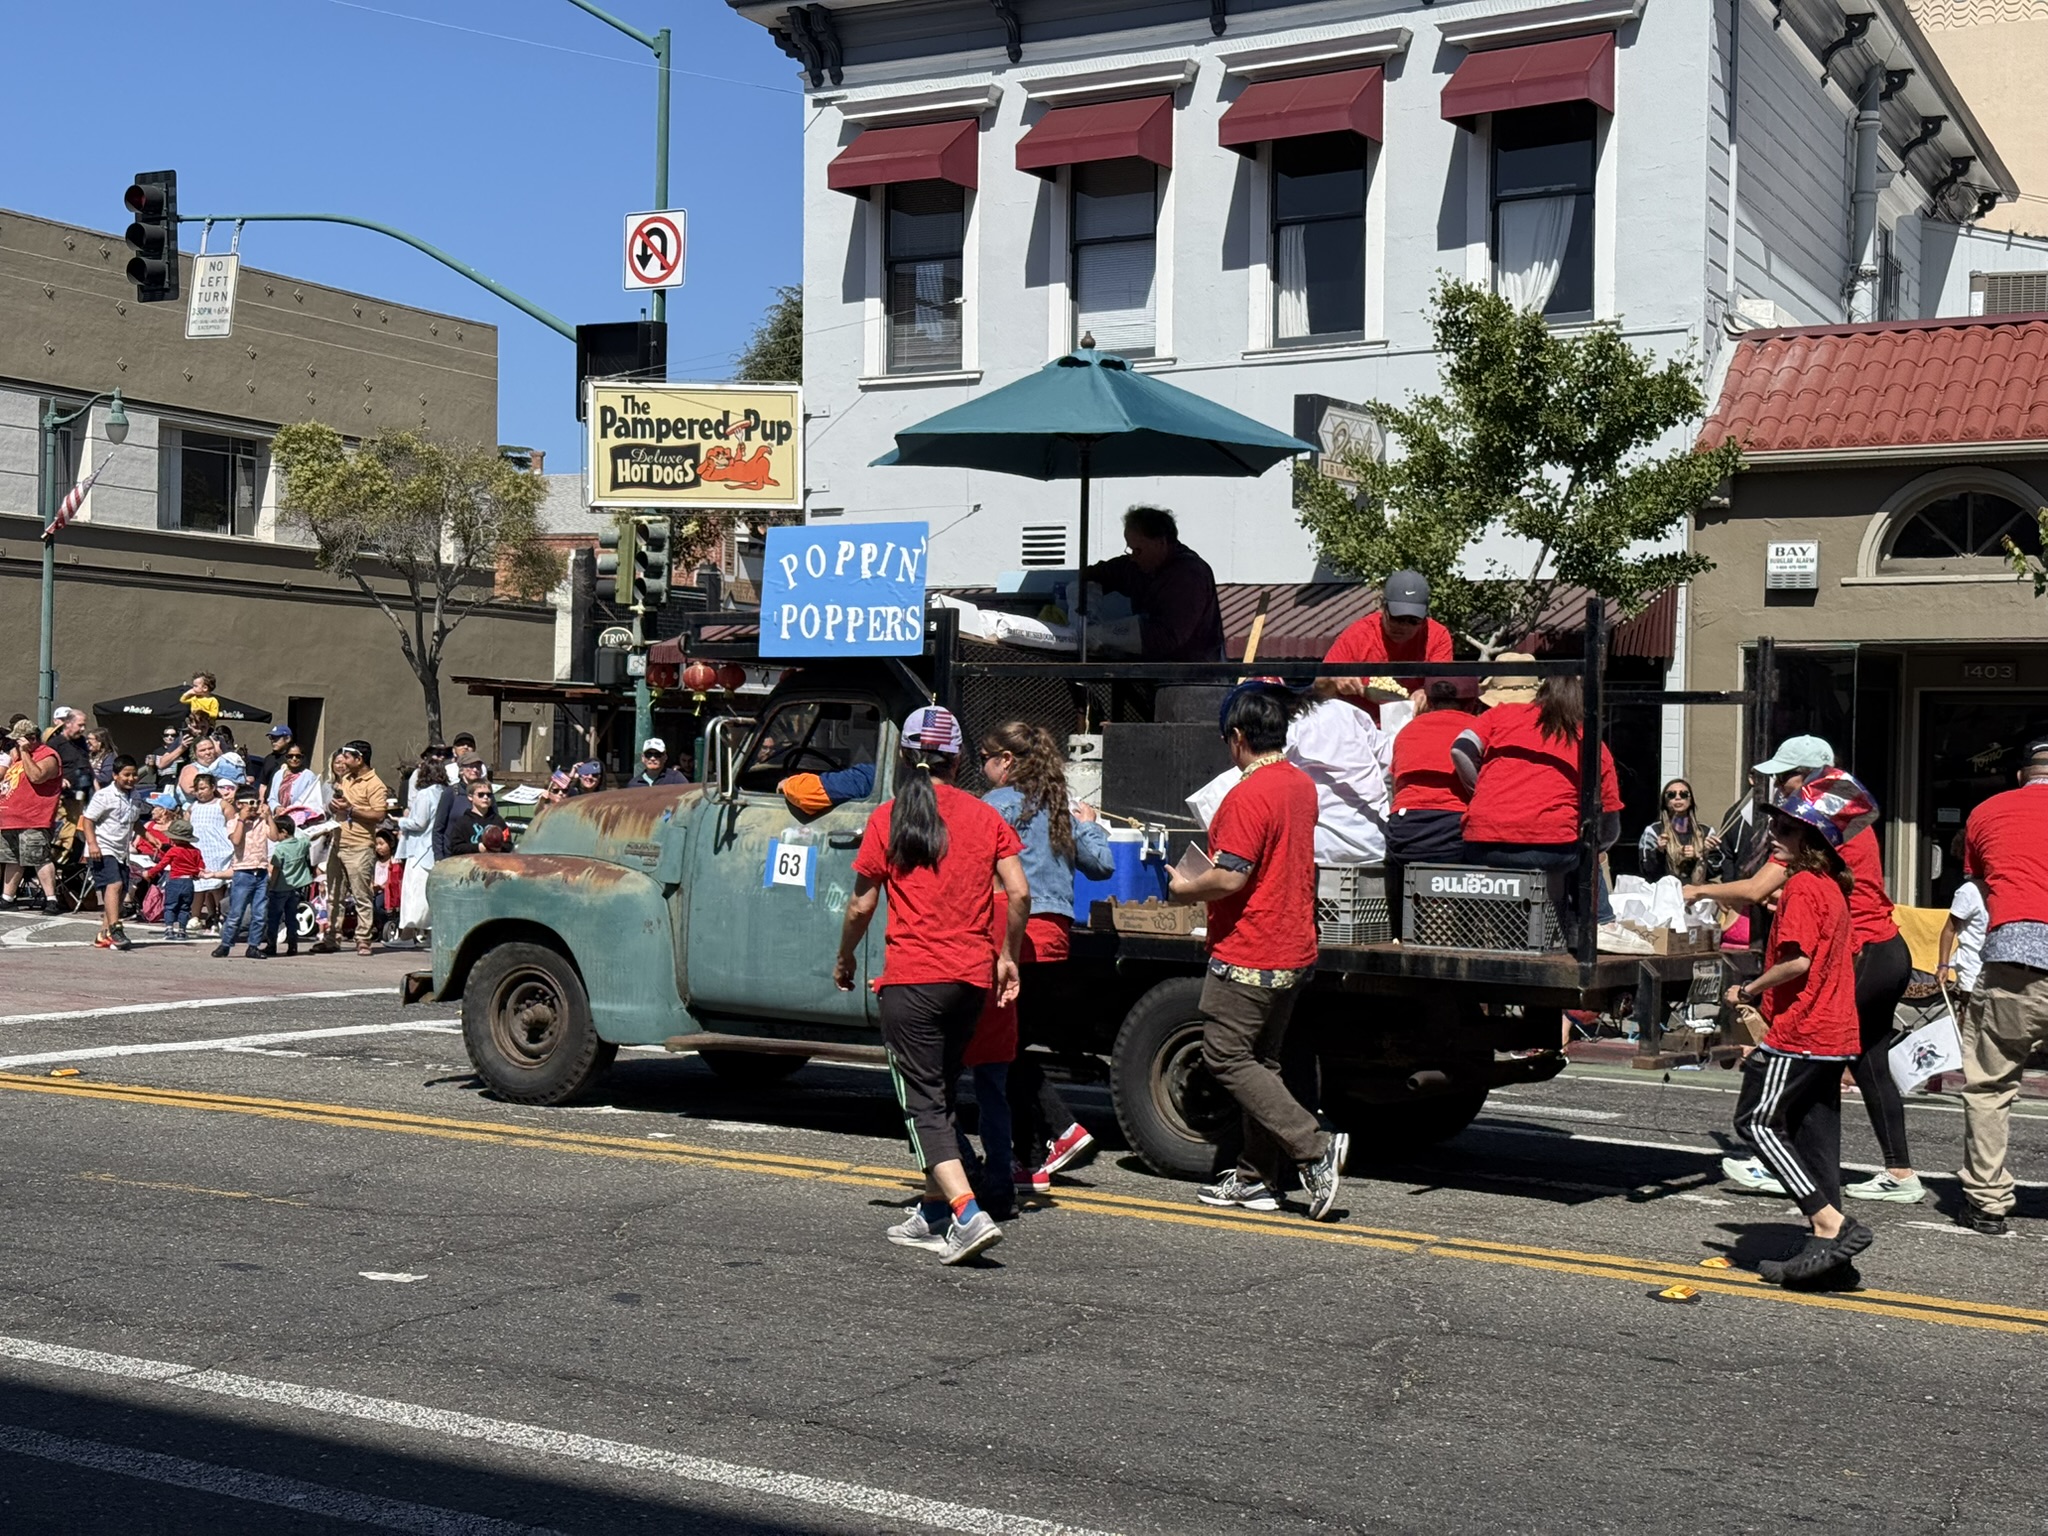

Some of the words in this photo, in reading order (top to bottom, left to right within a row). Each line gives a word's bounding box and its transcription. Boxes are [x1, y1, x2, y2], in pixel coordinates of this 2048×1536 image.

[209, 260, 223, 272] NO
[200, 276, 228, 287] LEFT
[198, 291, 228, 302] TURN
[621, 395, 650, 415] The
[600, 405, 730, 443] Pampered
[744, 408, 792, 445] Pup
[630, 447, 685, 464] Deluxe
[617, 458, 649, 483] HOT
[654, 458, 695, 485] DOGS
[1775, 546, 1811, 556] BAY
[778, 535, 927, 590] POPPIN'
[779, 603, 921, 643] POPPERS
[603, 633, 628, 645] TROY
[1964, 665, 2013, 679] 1403
[778, 852, 802, 877] 63
[1431, 876, 1521, 897] Lucerne
